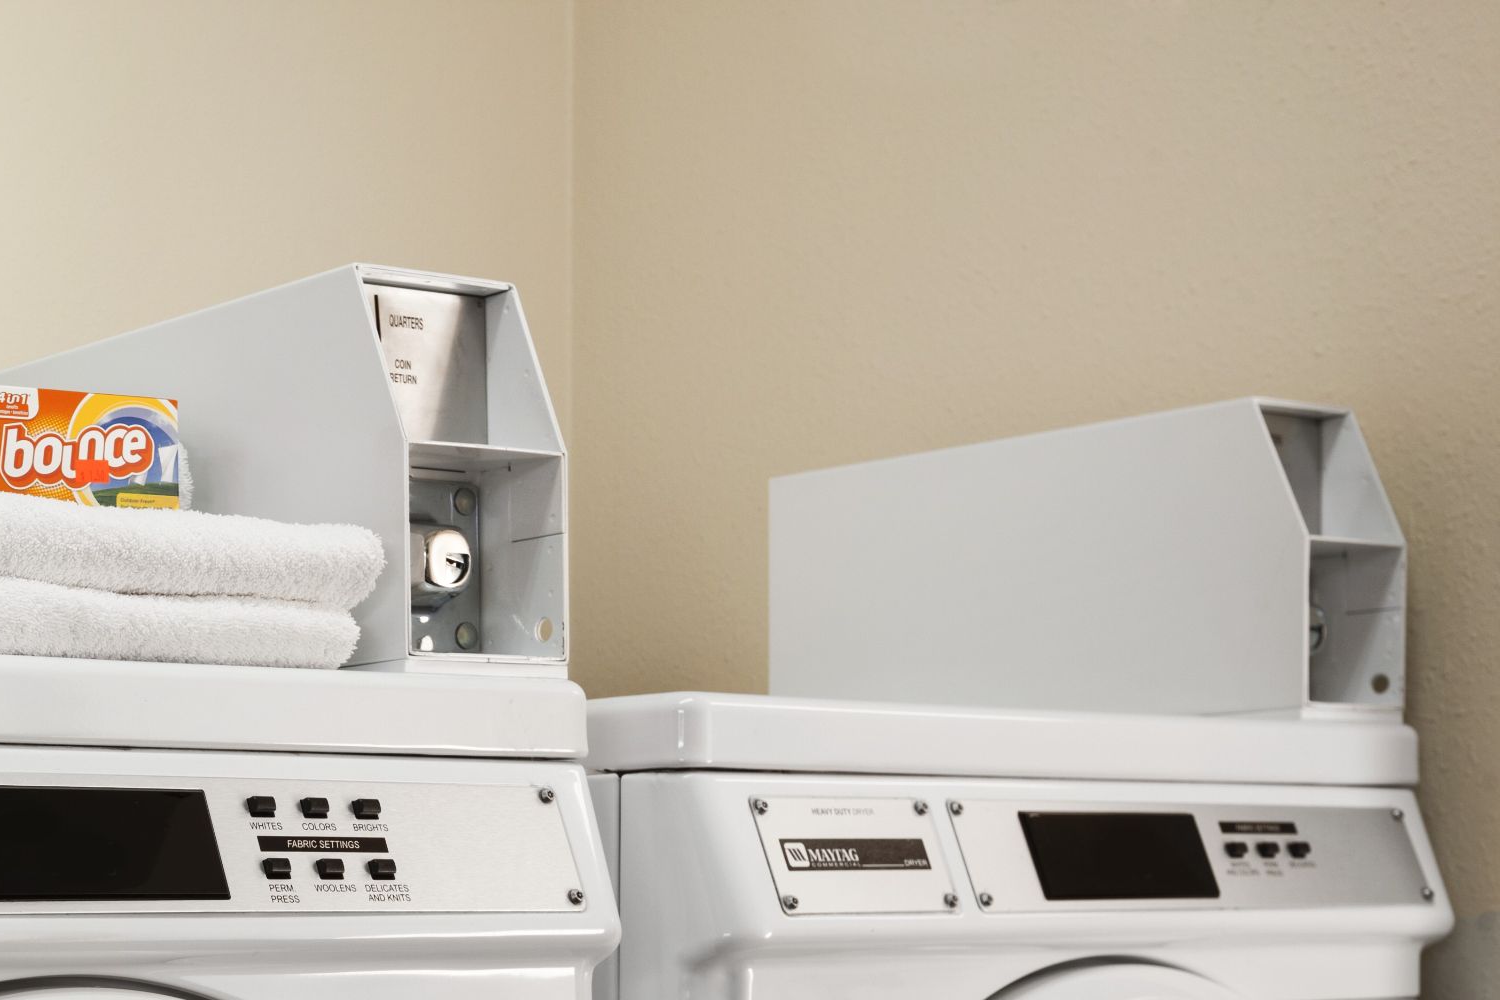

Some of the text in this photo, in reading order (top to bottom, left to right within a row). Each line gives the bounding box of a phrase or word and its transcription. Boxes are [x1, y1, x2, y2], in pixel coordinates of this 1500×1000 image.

[388, 314, 424, 330] QUARTERS
[394, 359, 412, 370] COIN
[389, 372, 417, 384] RETURN
[3, 427, 148, 479] bounce
[250, 822, 283, 831] WHITES
[302, 823, 337, 832] COLORS
[353, 824, 389, 832] BRIGHTS
[287, 839, 360, 849] FABRIC SETTINGS
[808, 848, 860, 861] MAYTAG
[269, 884, 296, 893] PERM.
[315, 884, 357, 893] WOOLENS
[365, 884, 410, 893] DELICATES
[271, 895, 301, 904] PRESS
[368, 894, 412, 903] AND KNITS
